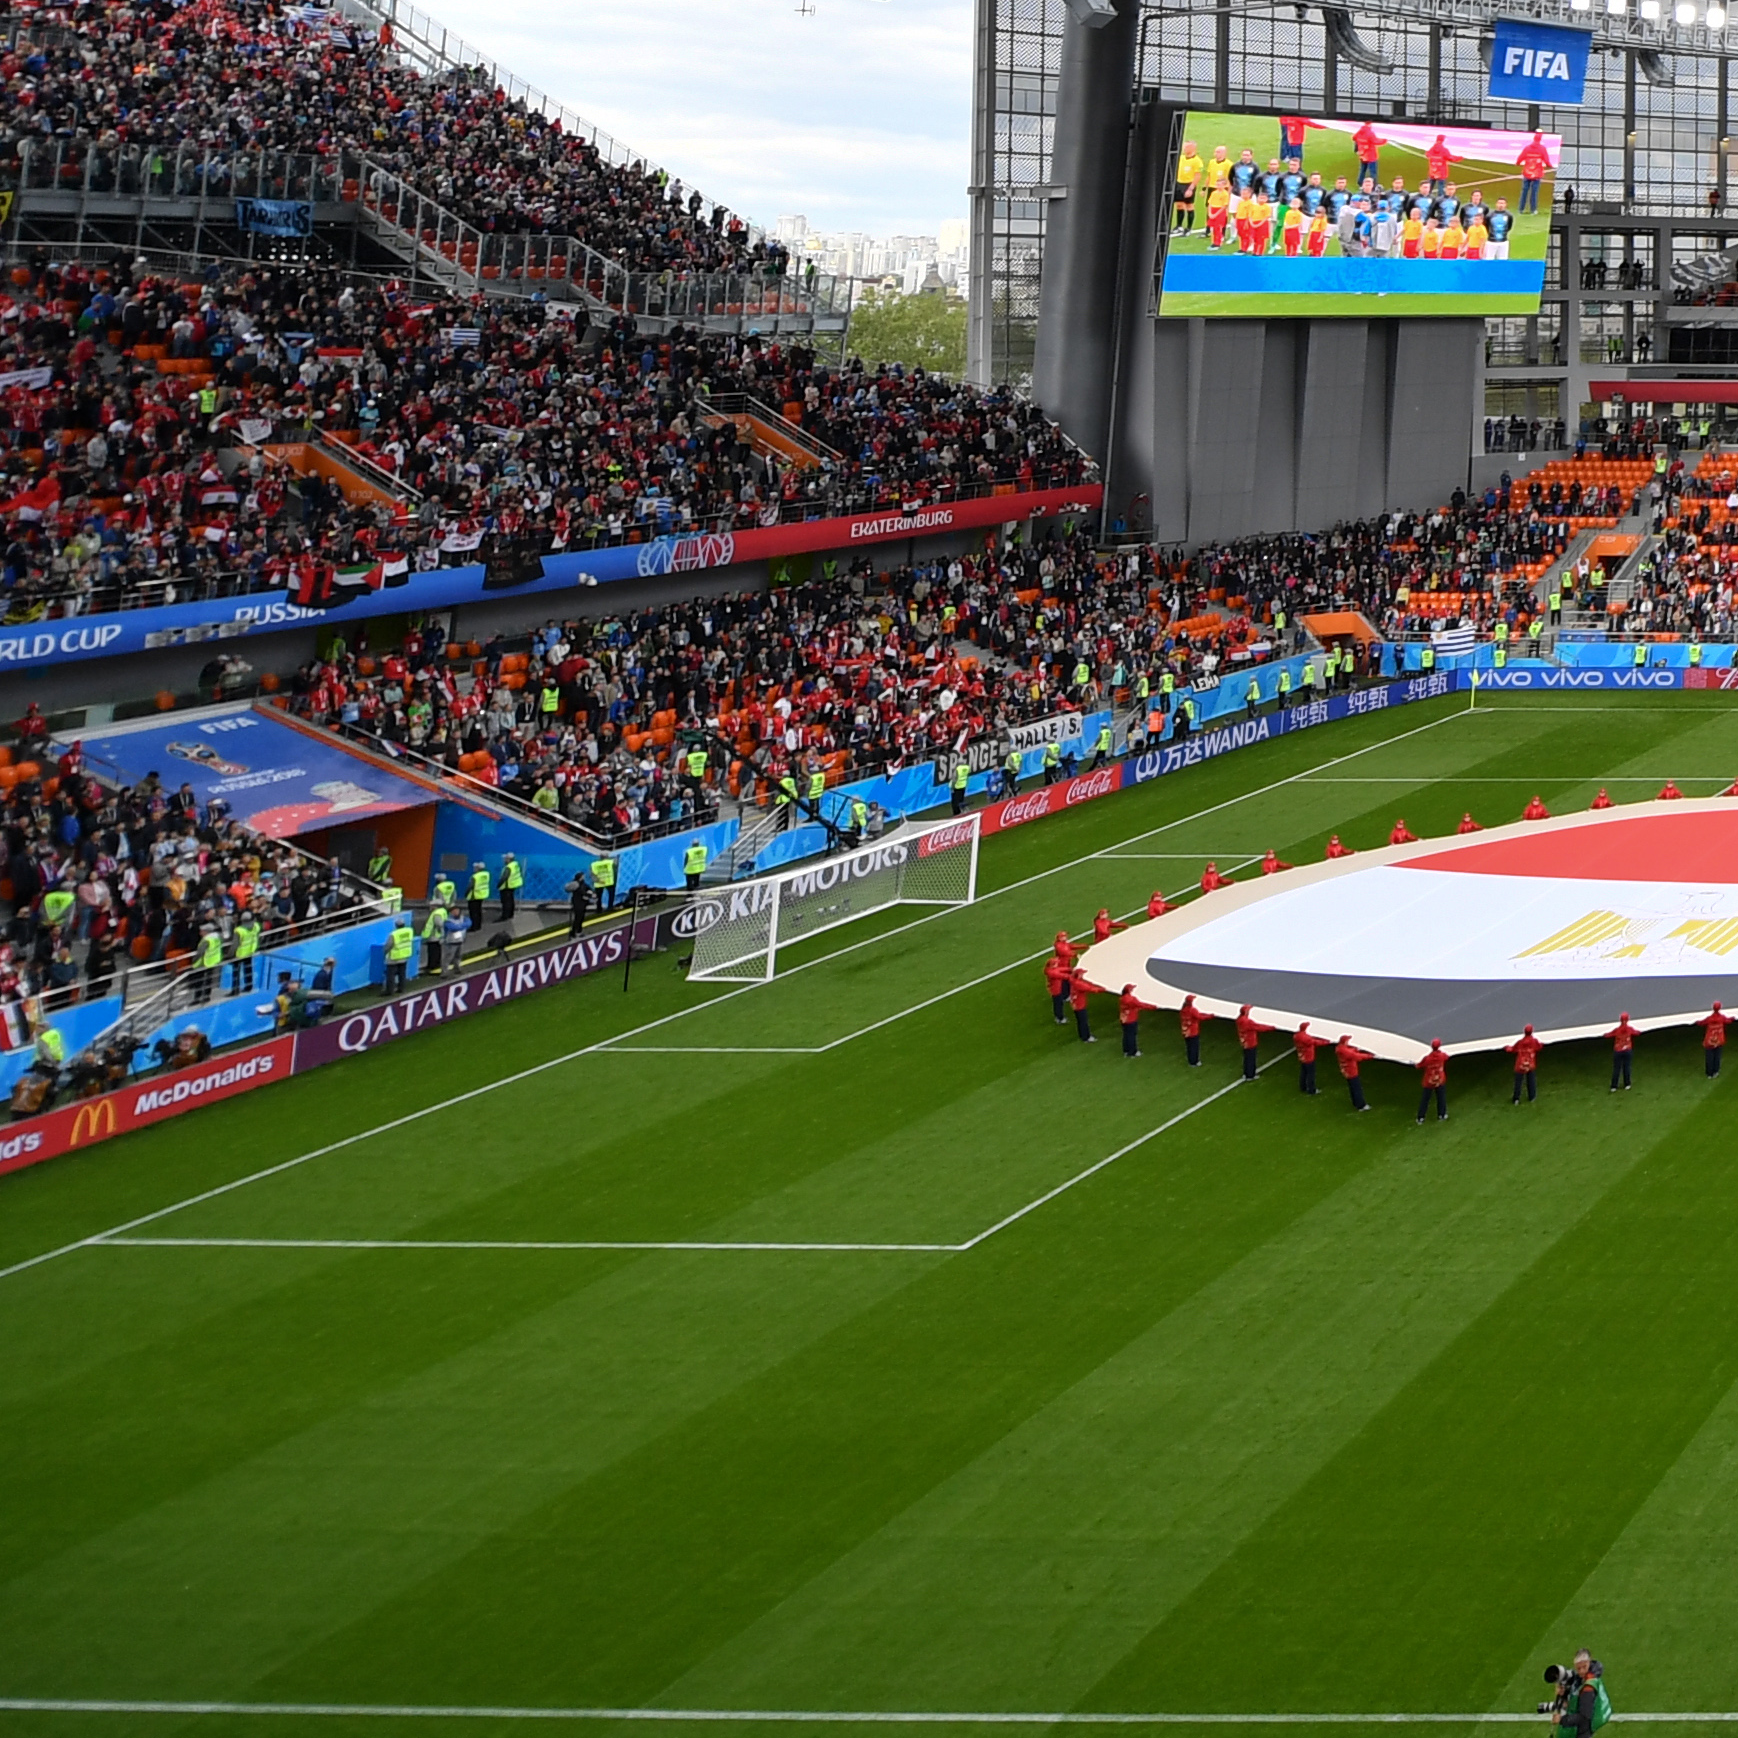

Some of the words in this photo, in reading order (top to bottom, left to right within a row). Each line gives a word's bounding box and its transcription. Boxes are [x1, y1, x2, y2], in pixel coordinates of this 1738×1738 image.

[1503, 46, 1570, 80] FIFA
[850, 509, 953, 539] EKATERINBURG
[61, 624, 122, 653] CUP
[1540, 669, 1603, 687] vivo
[1612, 669, 1675, 687] vivo
[199, 717, 258, 734] FIFA
[1065, 767, 1114, 805] Coca-Cola
[1000, 788, 1051, 828] Coca-Cola
[728, 882, 778, 922] KIA
[791, 843, 908, 897] MOTORS
[681, 908, 715, 930] KIA
[337, 984, 469, 1053] QATAR
[476, 930, 624, 1004] AIRWAYS
[134, 1053, 274, 1115] McDonald's
